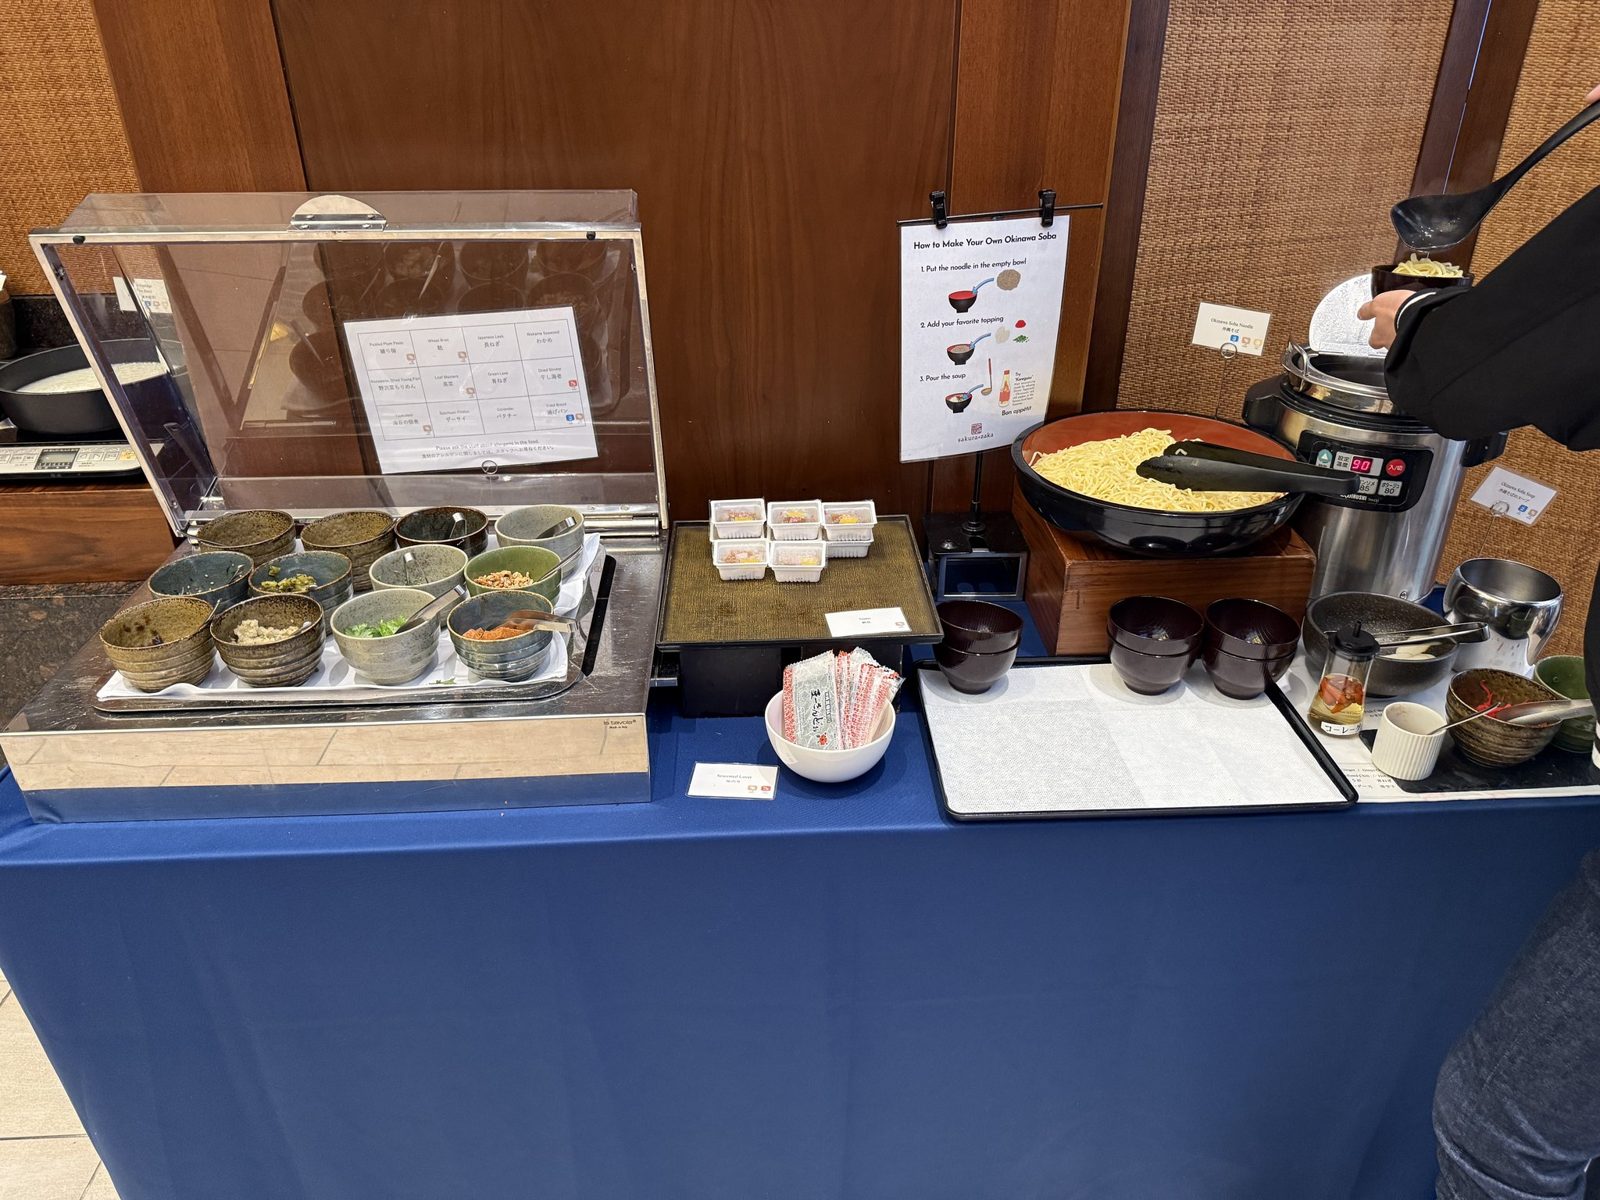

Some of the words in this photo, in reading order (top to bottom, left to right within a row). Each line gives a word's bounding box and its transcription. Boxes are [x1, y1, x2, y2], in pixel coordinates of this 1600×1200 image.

[913, 241, 930, 250] How
[942, 240, 964, 248] Make
[966, 238, 983, 246] Your
[1004, 234, 1036, 243] Okinawa
[1038, 232, 1057, 241] Soba
[950, 262, 971, 270] noodle
[980, 260, 991, 268] the
[992, 260, 1011, 268] empty
[956, 318, 979, 326] favorite
[981, 315, 1004, 324] topping
[1352, 460, 1370, 471] 90
